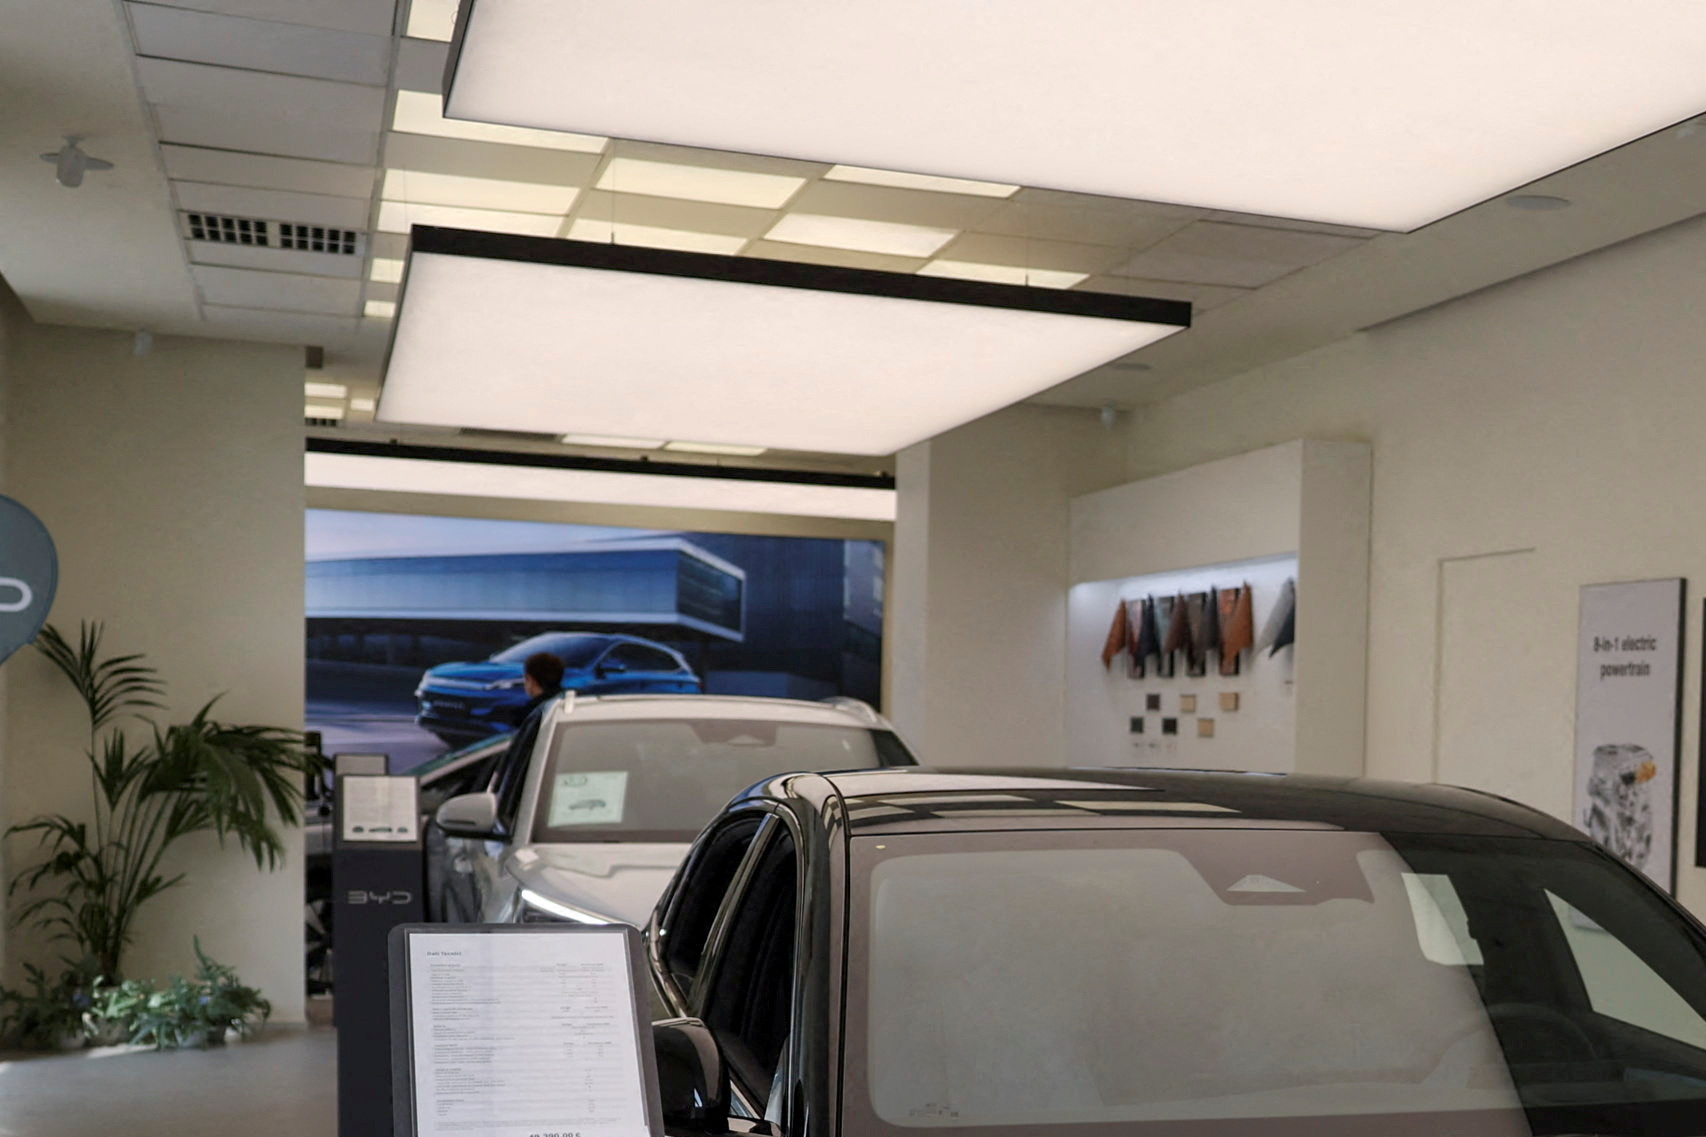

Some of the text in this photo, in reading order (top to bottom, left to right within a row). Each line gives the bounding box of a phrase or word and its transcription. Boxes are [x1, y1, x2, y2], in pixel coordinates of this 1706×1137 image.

[1621, 635, 1657, 651] electric
[1600, 661, 1650, 681] powertrain
[347, 890, 412, 904] BYD
